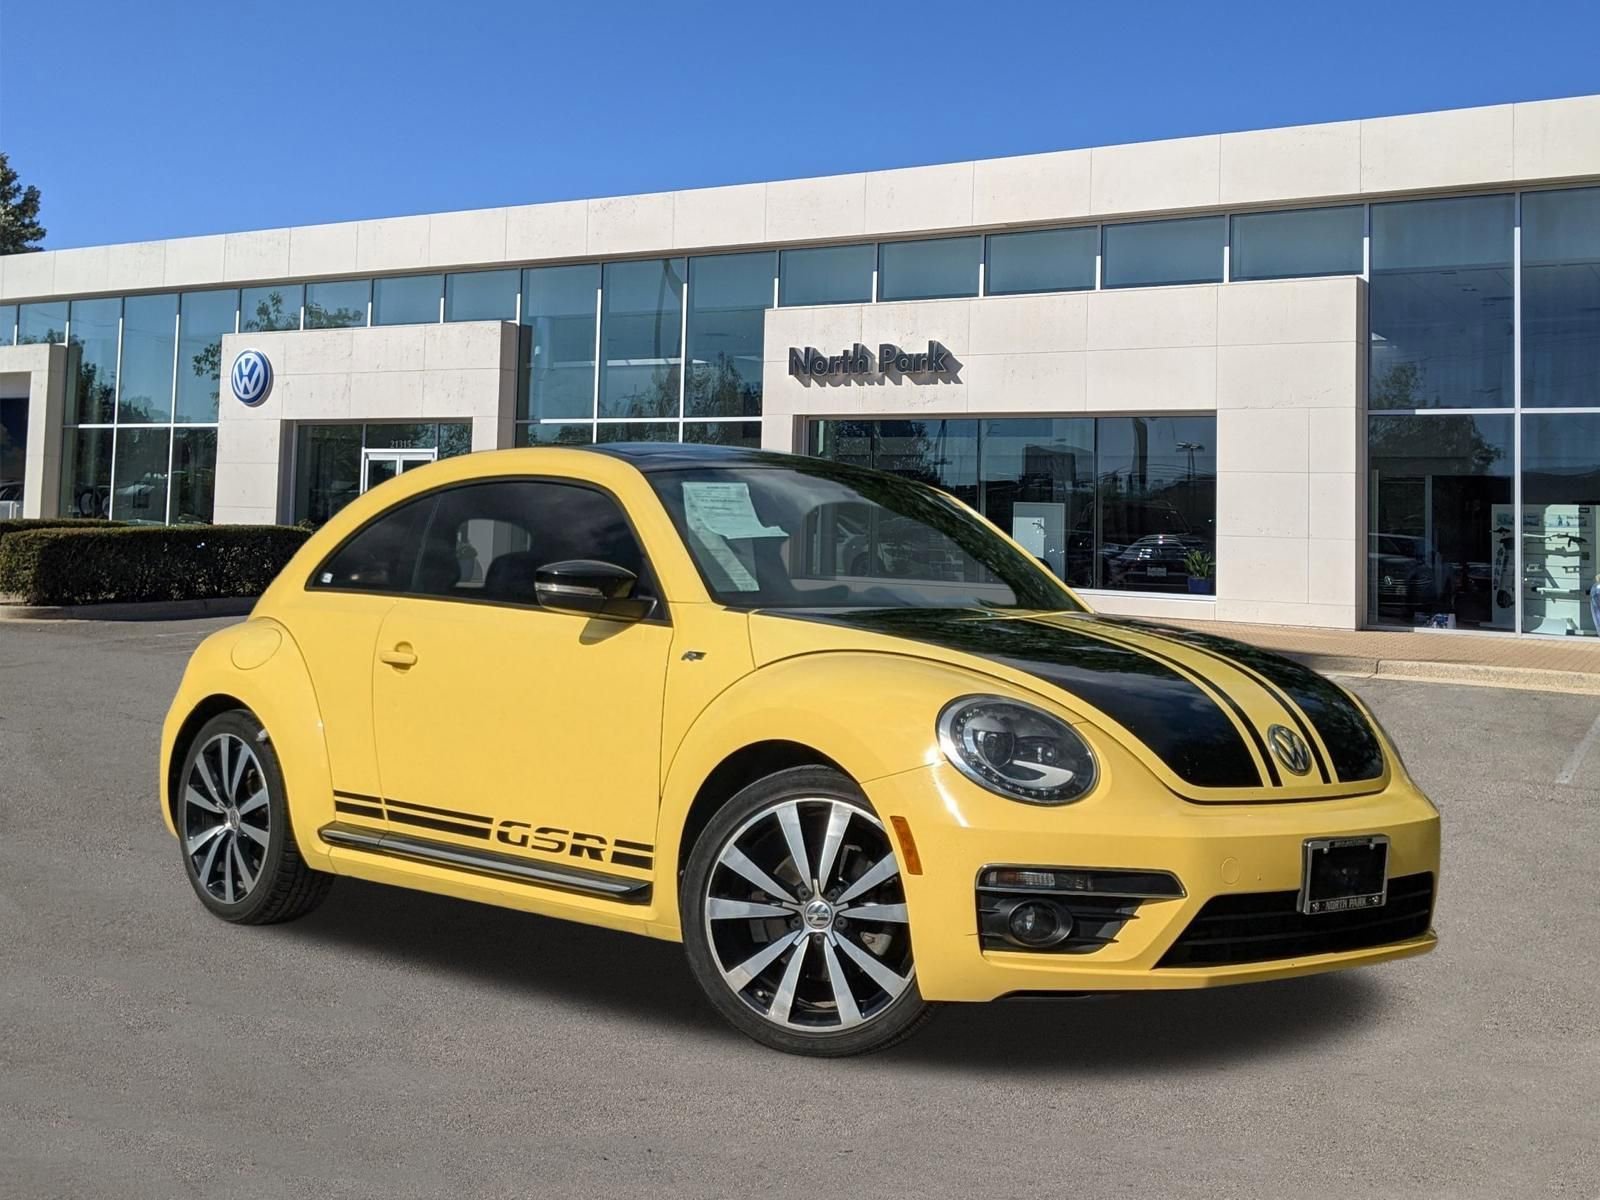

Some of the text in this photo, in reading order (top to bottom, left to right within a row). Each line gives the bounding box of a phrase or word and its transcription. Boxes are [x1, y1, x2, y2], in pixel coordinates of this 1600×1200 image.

[232, 351, 267, 402] VW
[788, 340, 947, 376] North Park
[1268, 725, 1311, 775] VW
[496, 820, 608, 862] GSR
